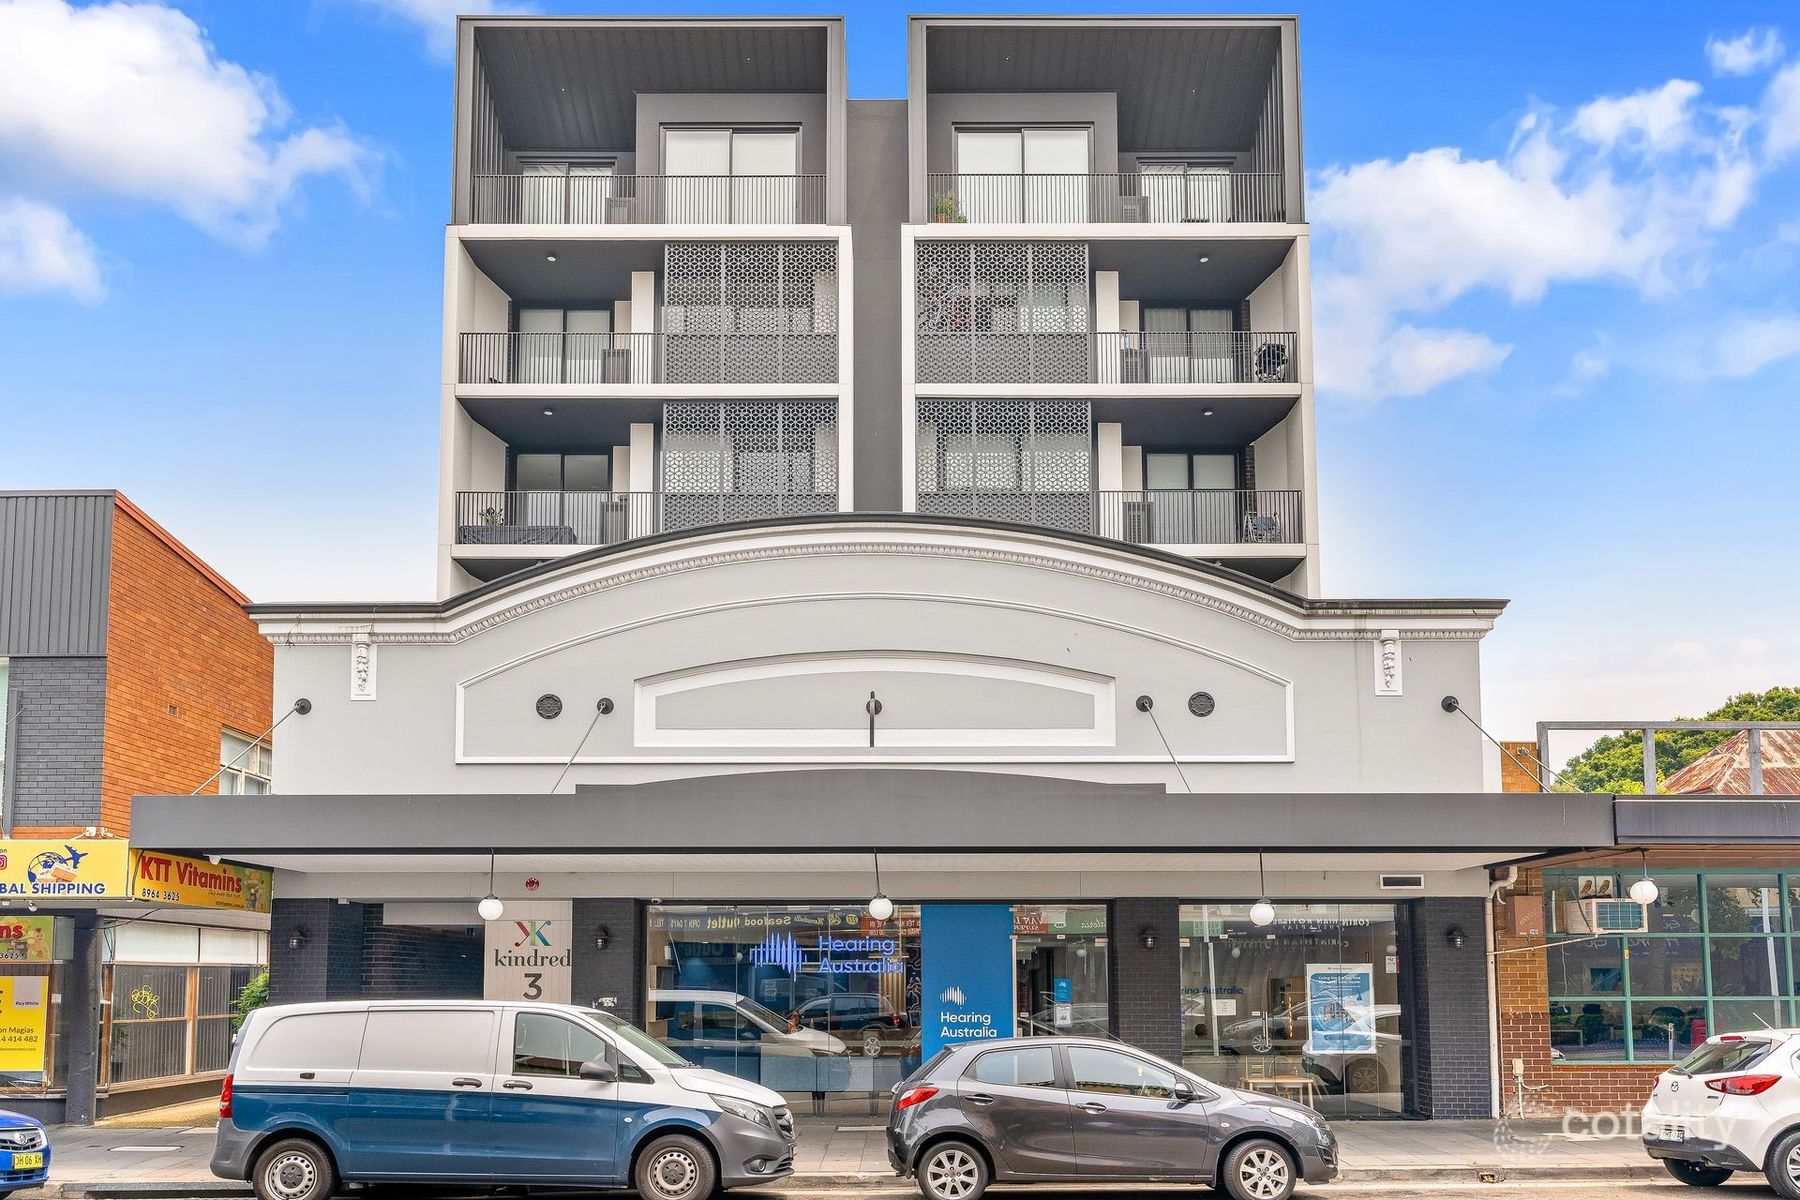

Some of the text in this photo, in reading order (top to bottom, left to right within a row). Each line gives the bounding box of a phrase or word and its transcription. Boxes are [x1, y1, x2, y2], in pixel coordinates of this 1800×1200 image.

[141, 855, 242, 893] KTT Vitamins
[32, 883, 106, 895] SHIPPING
[142, 888, 180, 901] 8964 3625
[819, 935, 895, 955] Hearing
[494, 949, 571, 967] kindred
[819, 957, 904, 973] Australia
[522, 973, 543, 1000] 3
[940, 1011, 991, 1026] Hearing
[9, 1026, 35, 1035] Magias
[940, 1026, 998, 1038] Australia
[8, 1035, 22, 1043] 414
[24, 1035, 39, 1043] 482
